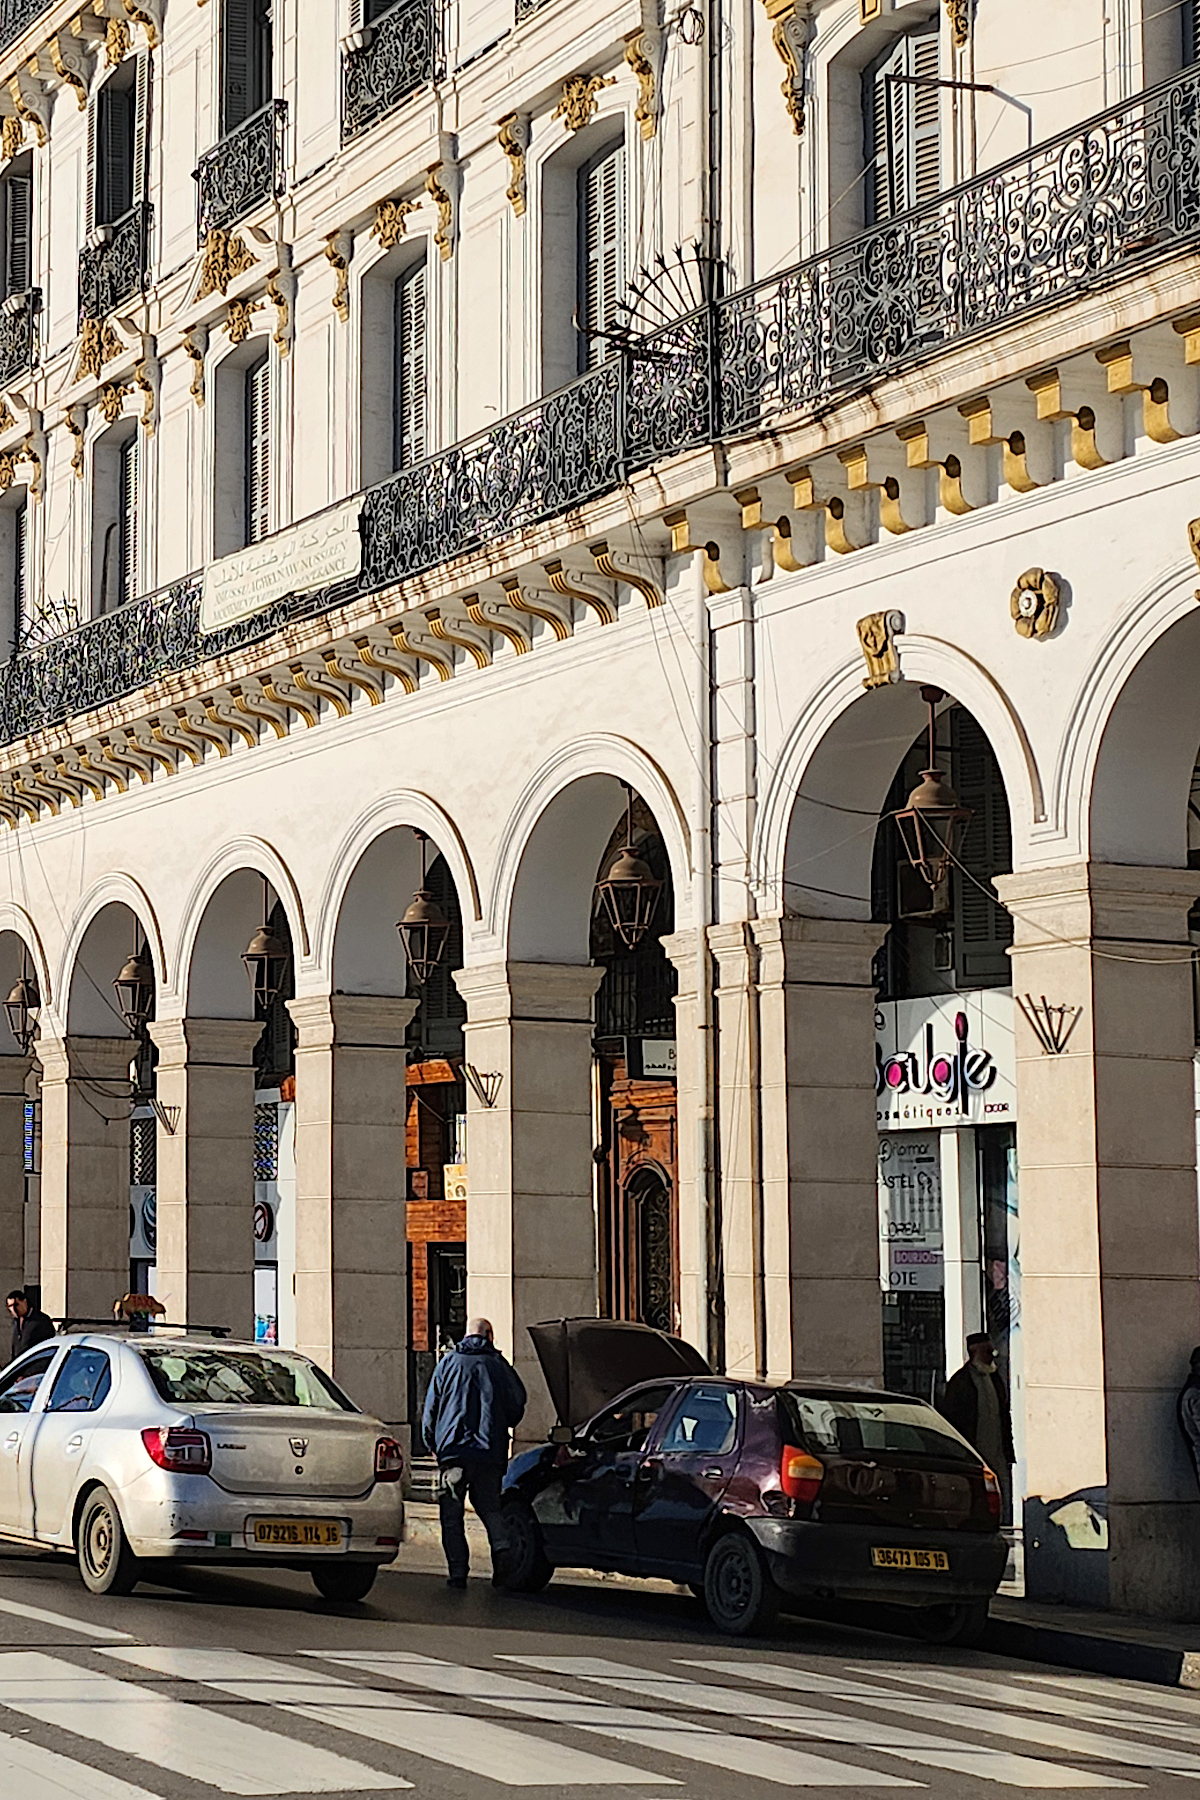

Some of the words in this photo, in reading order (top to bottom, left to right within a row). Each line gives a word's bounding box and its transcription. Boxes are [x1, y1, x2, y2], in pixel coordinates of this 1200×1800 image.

[876, 1104, 961, 1126] osmétiques
[879, 1174, 915, 1189] ASTEL
[933, 1552, 945, 1568] 16
